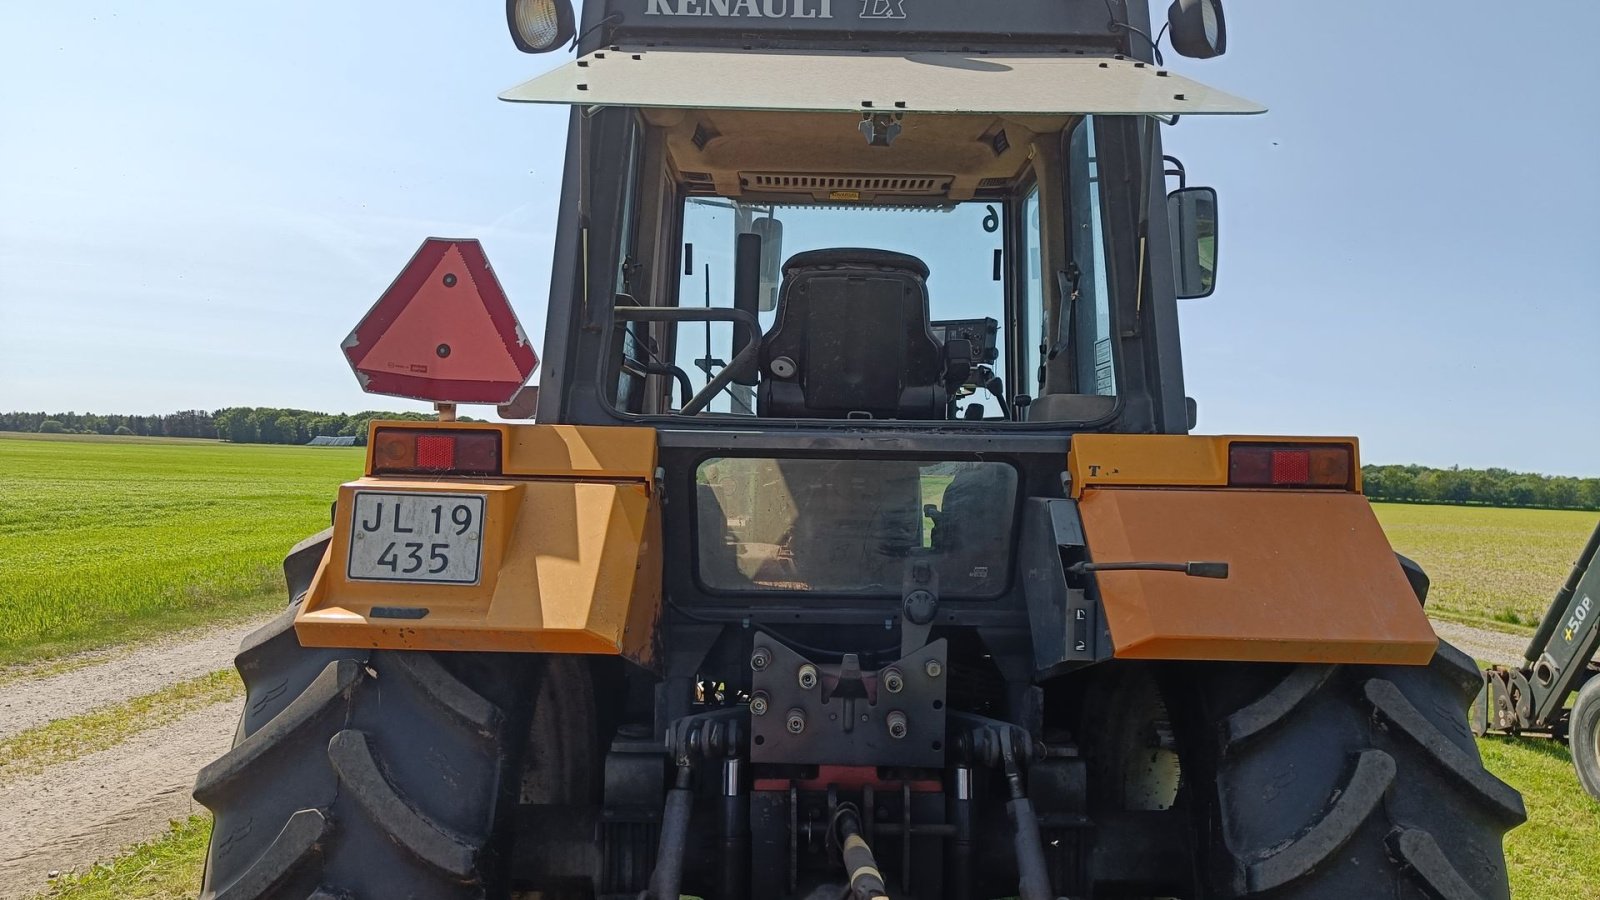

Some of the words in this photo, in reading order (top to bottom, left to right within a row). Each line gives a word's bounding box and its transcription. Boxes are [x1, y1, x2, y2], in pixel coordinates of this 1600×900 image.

[362, 502, 413, 533] JL
[431, 504, 472, 536] 19
[377, 541, 449, 574] 435
